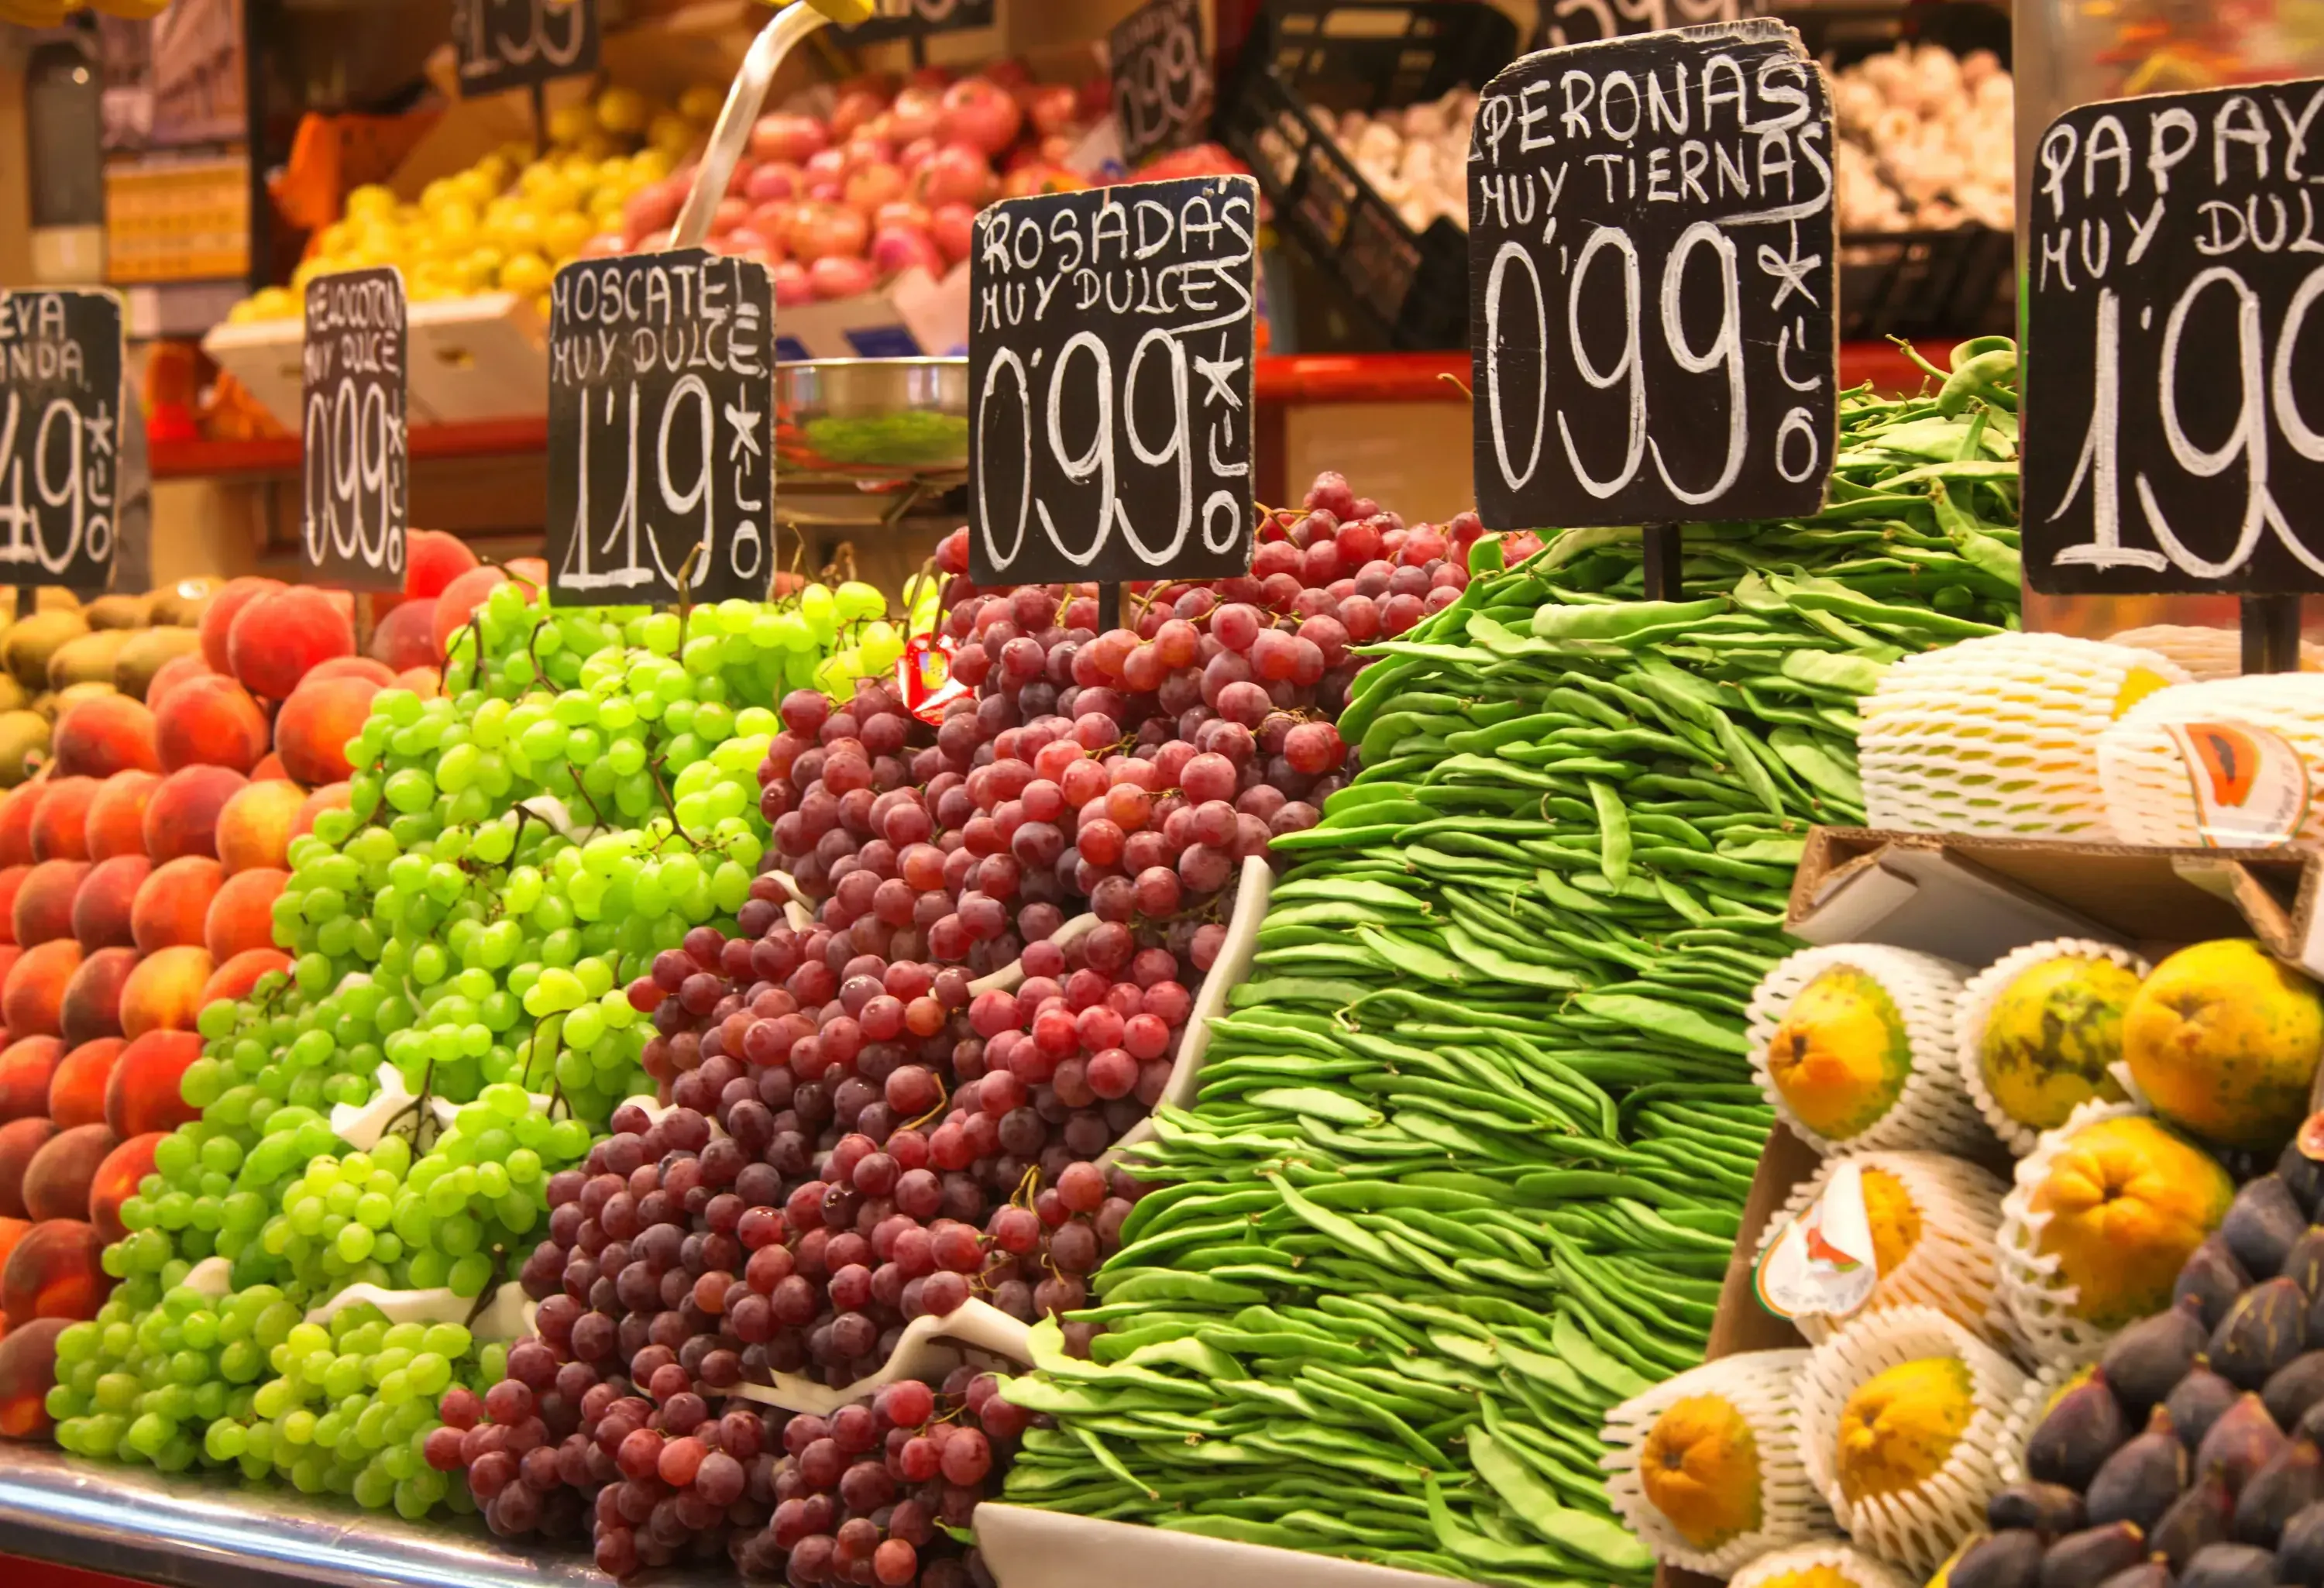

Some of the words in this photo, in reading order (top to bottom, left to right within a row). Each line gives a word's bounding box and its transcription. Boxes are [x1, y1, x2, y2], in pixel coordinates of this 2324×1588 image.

[1482, 53, 1810, 167] PERONAS
[2040, 86, 2324, 222] PAPAY
[981, 196, 1253, 273] ROSADAS
[1478, 160, 1569, 244] MUY
[2040, 197, 2165, 292] MUY
[551, 257, 760, 341] MOSCATEL
[978, 273, 1062, 333] MUY
[1073, 265, 1252, 335] DULCES
[552, 328, 617, 387] MUY
[633, 317, 765, 378] DULCE
